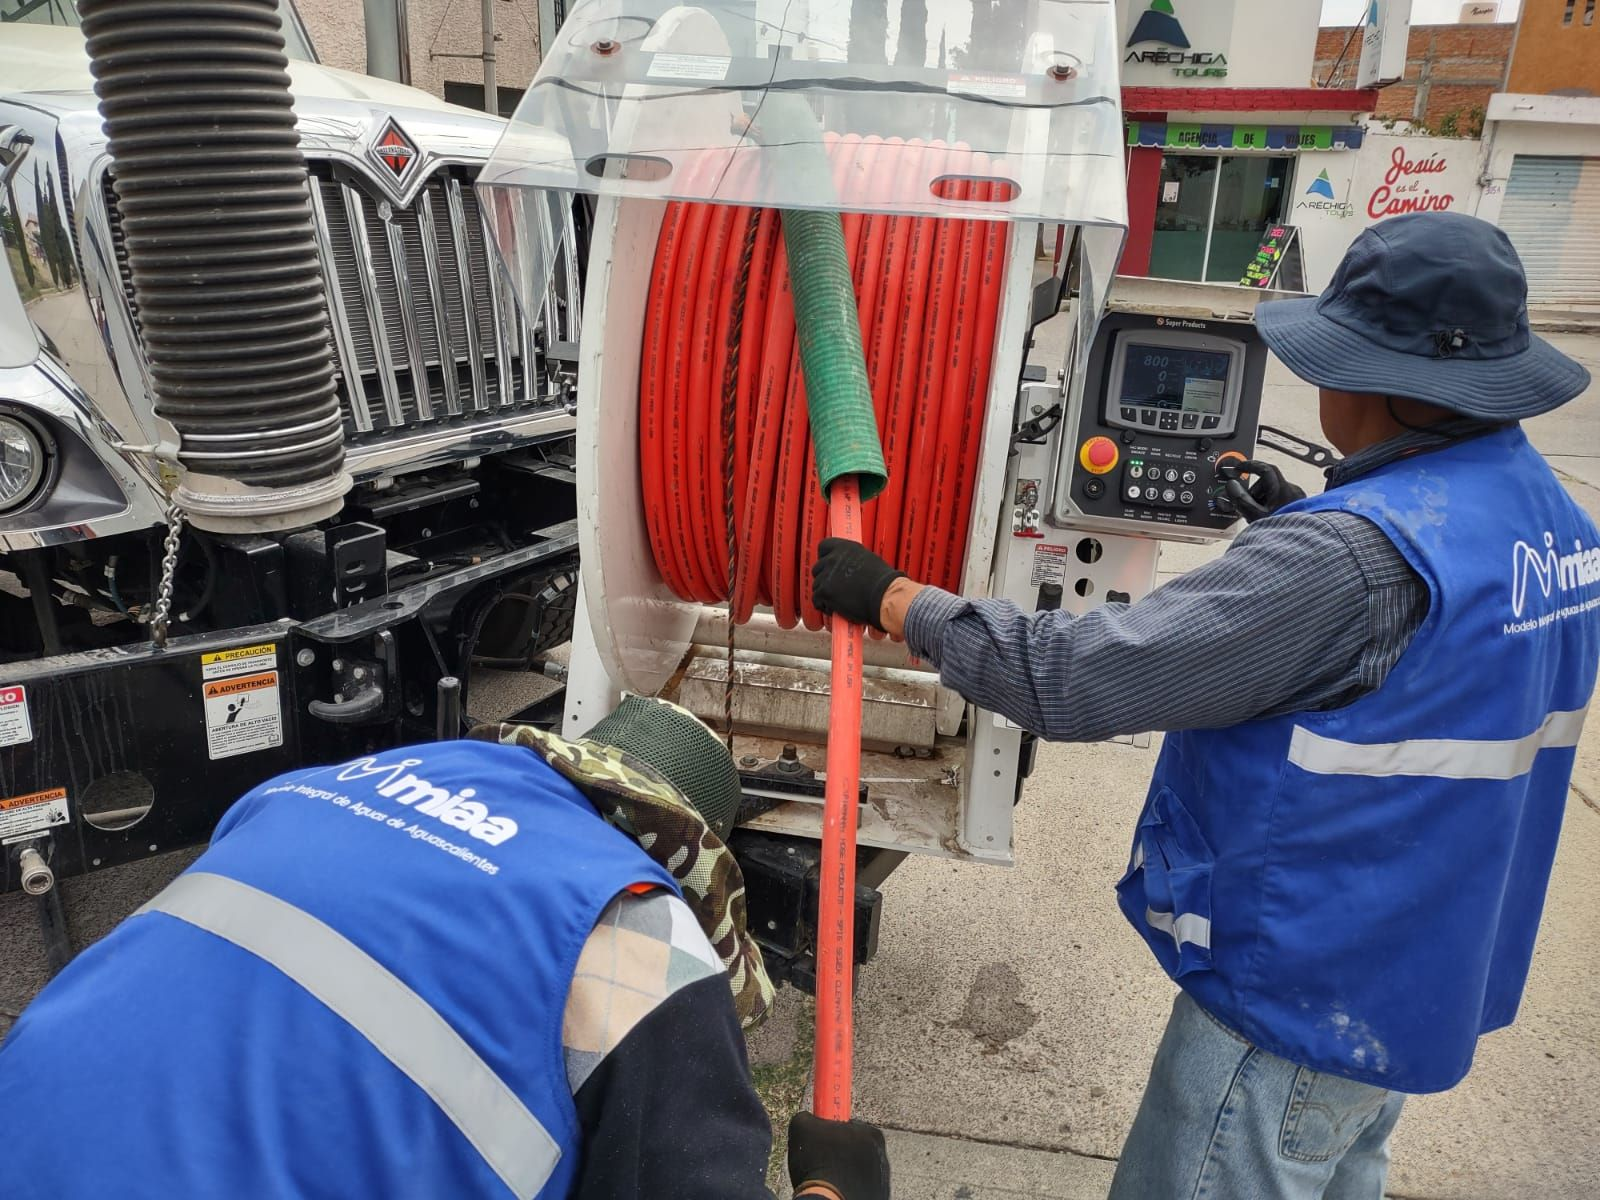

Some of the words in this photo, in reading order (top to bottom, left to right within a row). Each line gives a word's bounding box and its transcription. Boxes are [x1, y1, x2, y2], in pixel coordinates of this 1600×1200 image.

[1172, 67, 1228, 78] TOURS
[1178, 130, 1217, 144] AGENCIA
[1243, 132, 1255, 145] DE
[1286, 132, 1316, 145] VIAJES
[1384, 146, 1447, 186] Jesús
[1395, 184, 1407, 193] es
[1407, 180, 1419, 193] el
[1367, 186, 1455, 219] Camino
[1165, 318, 1182, 328] Super
[1182, 320, 1206, 330] Products
[1143, 354, 1170, 368] 800
[1157, 370, 1167, 382] 0
[1156, 383, 1166, 395] 0
[1503, 618, 1538, 636] Modelo
[219, 677, 275, 694] ADVERTENCIA
[8, 791, 63, 808] ADVERTENCIA
[376, 773, 519, 847] miaa
[294, 785, 339, 800] Integral
[332, 792, 350, 808] de
[349, 800, 388, 823] Aguas
[386, 814, 406, 830] de
[402, 823, 500, 876] Aguascalientes
